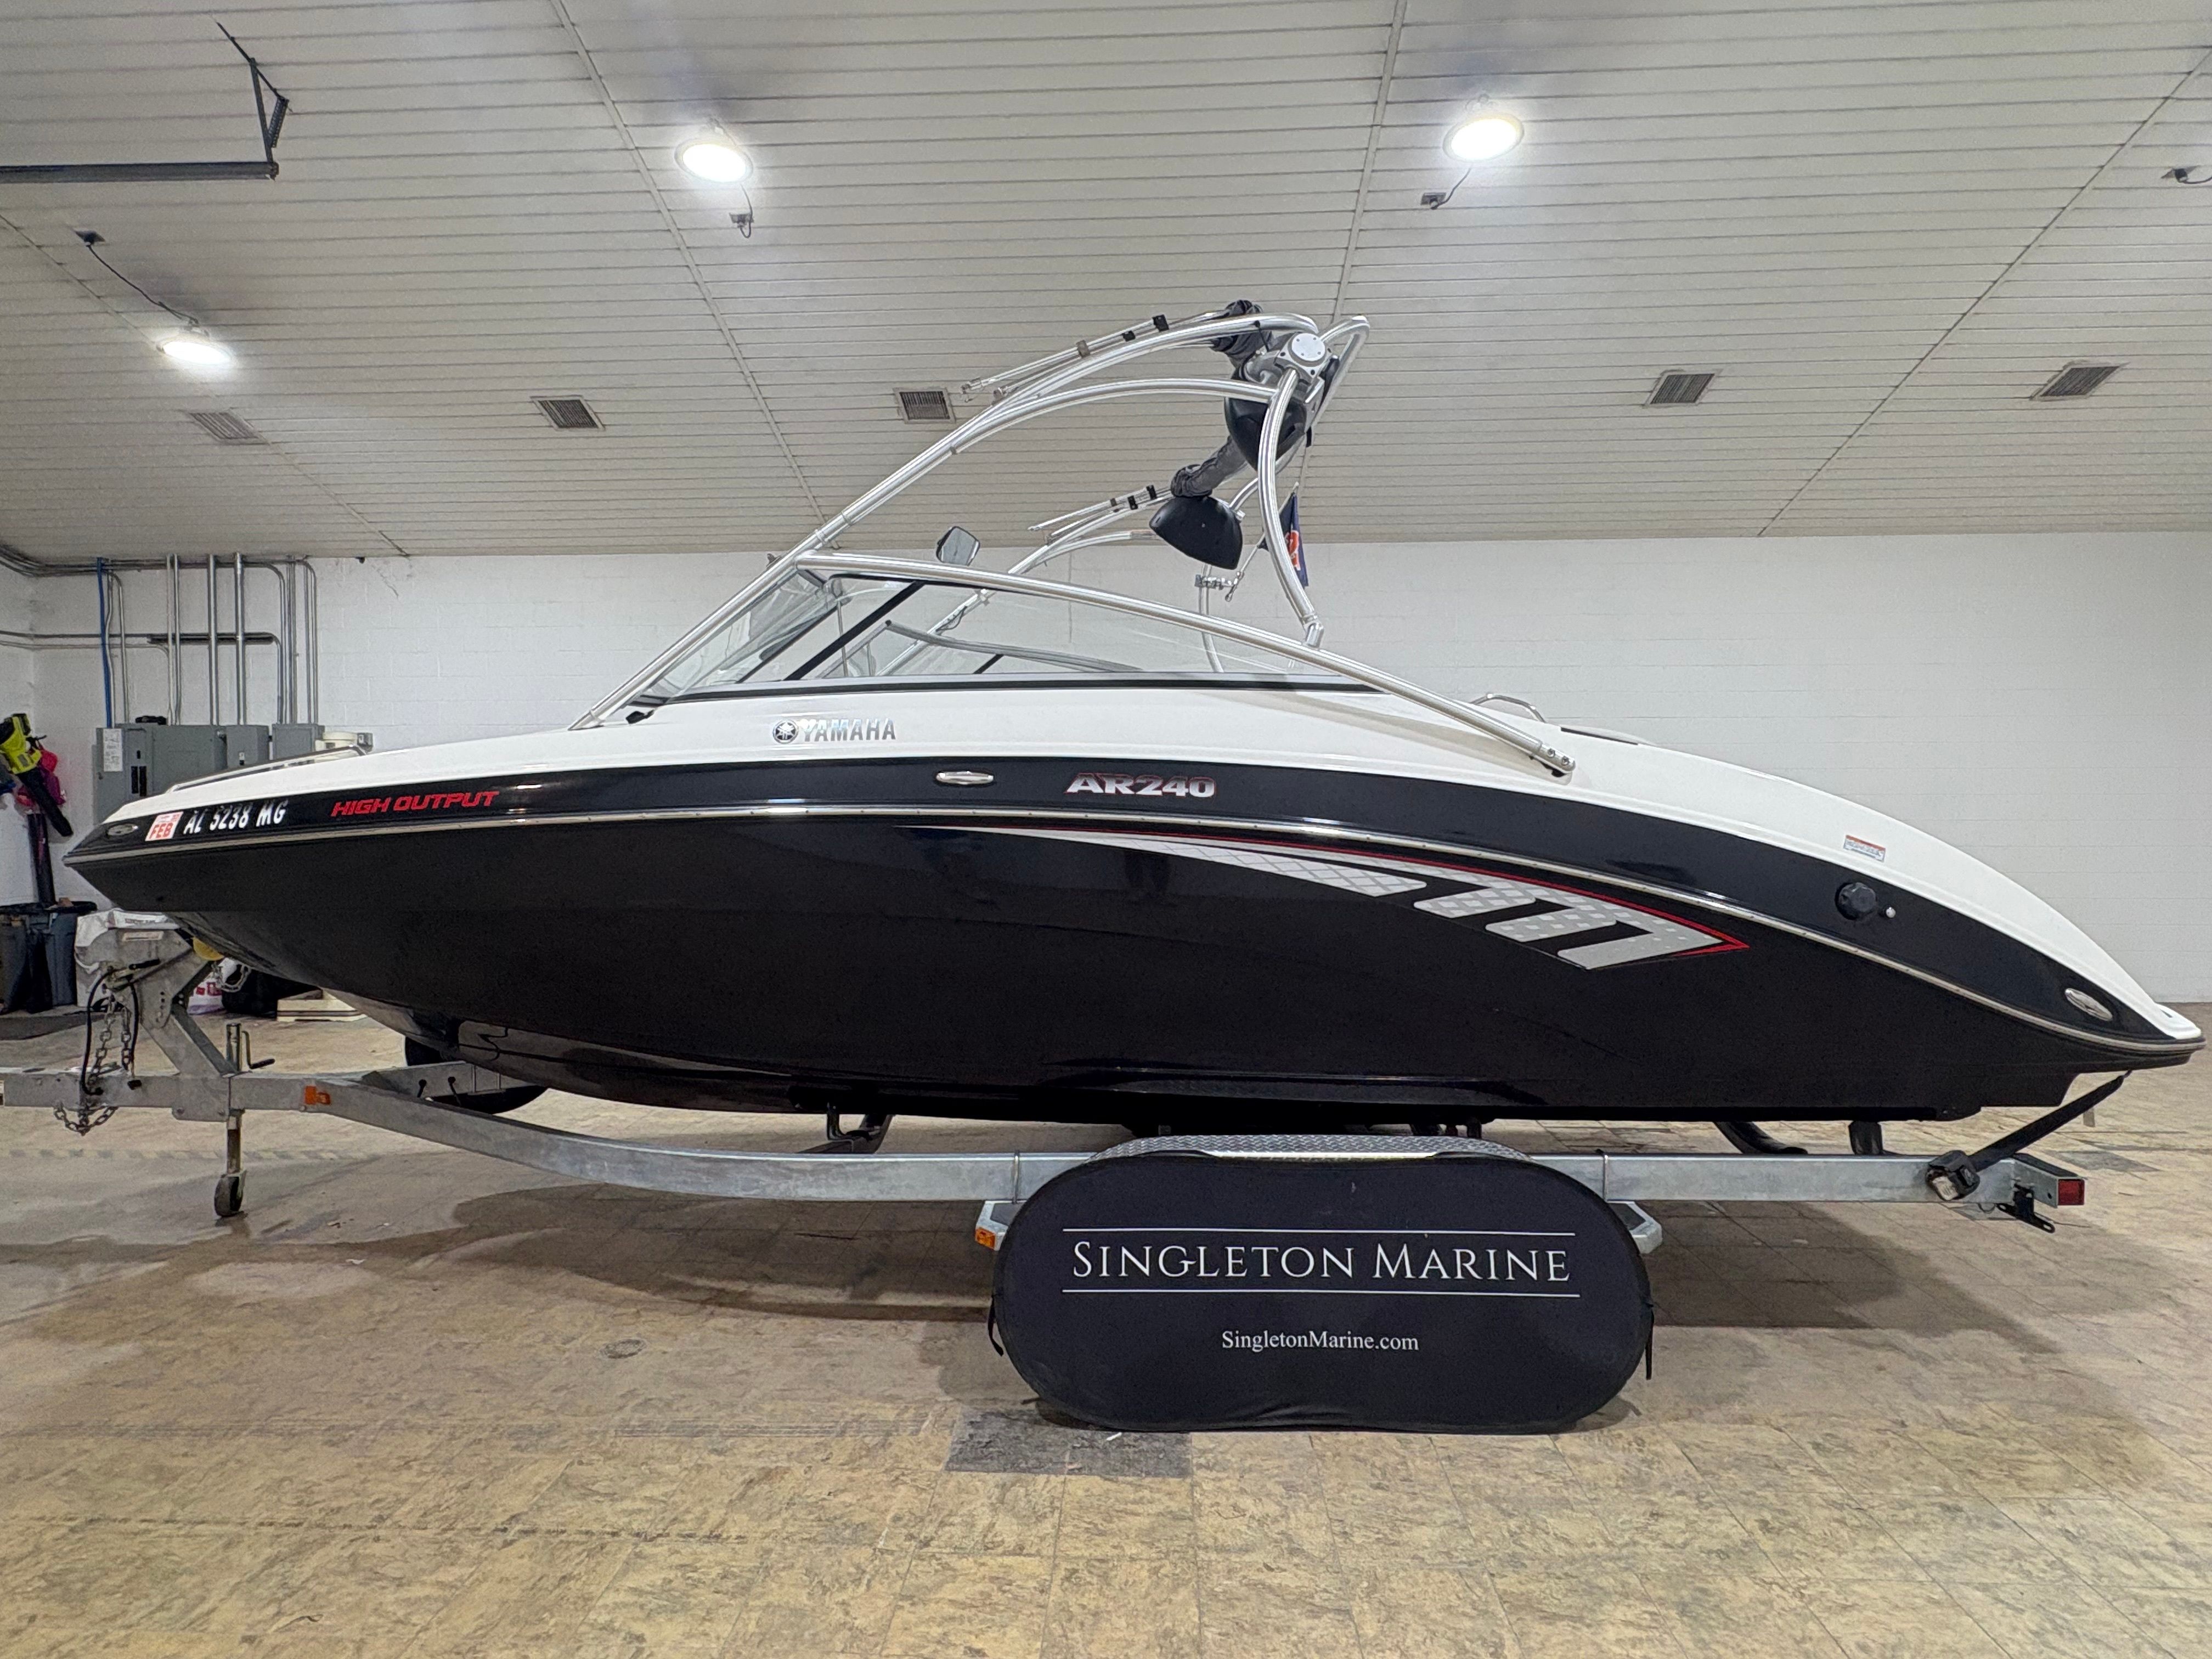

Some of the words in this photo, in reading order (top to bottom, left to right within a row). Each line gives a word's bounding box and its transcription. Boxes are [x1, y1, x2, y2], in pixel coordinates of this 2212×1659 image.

[798, 718, 896, 742] YAMAHA
[1064, 772, 1216, 798] AR240
[183, 809, 208, 834] AL
[210, 802, 253, 831] 5238
[256, 799, 289, 827] MG
[330, 797, 392, 817] HIGH
[393, 791, 500, 811] OUTPUT
[149, 822, 173, 839] FEB
[1073, 1241, 1354, 1278] SINGLETON
[1372, 1243, 1570, 1282] MARINE
[1222, 1330, 1419, 1352] SingletonMarine.com
